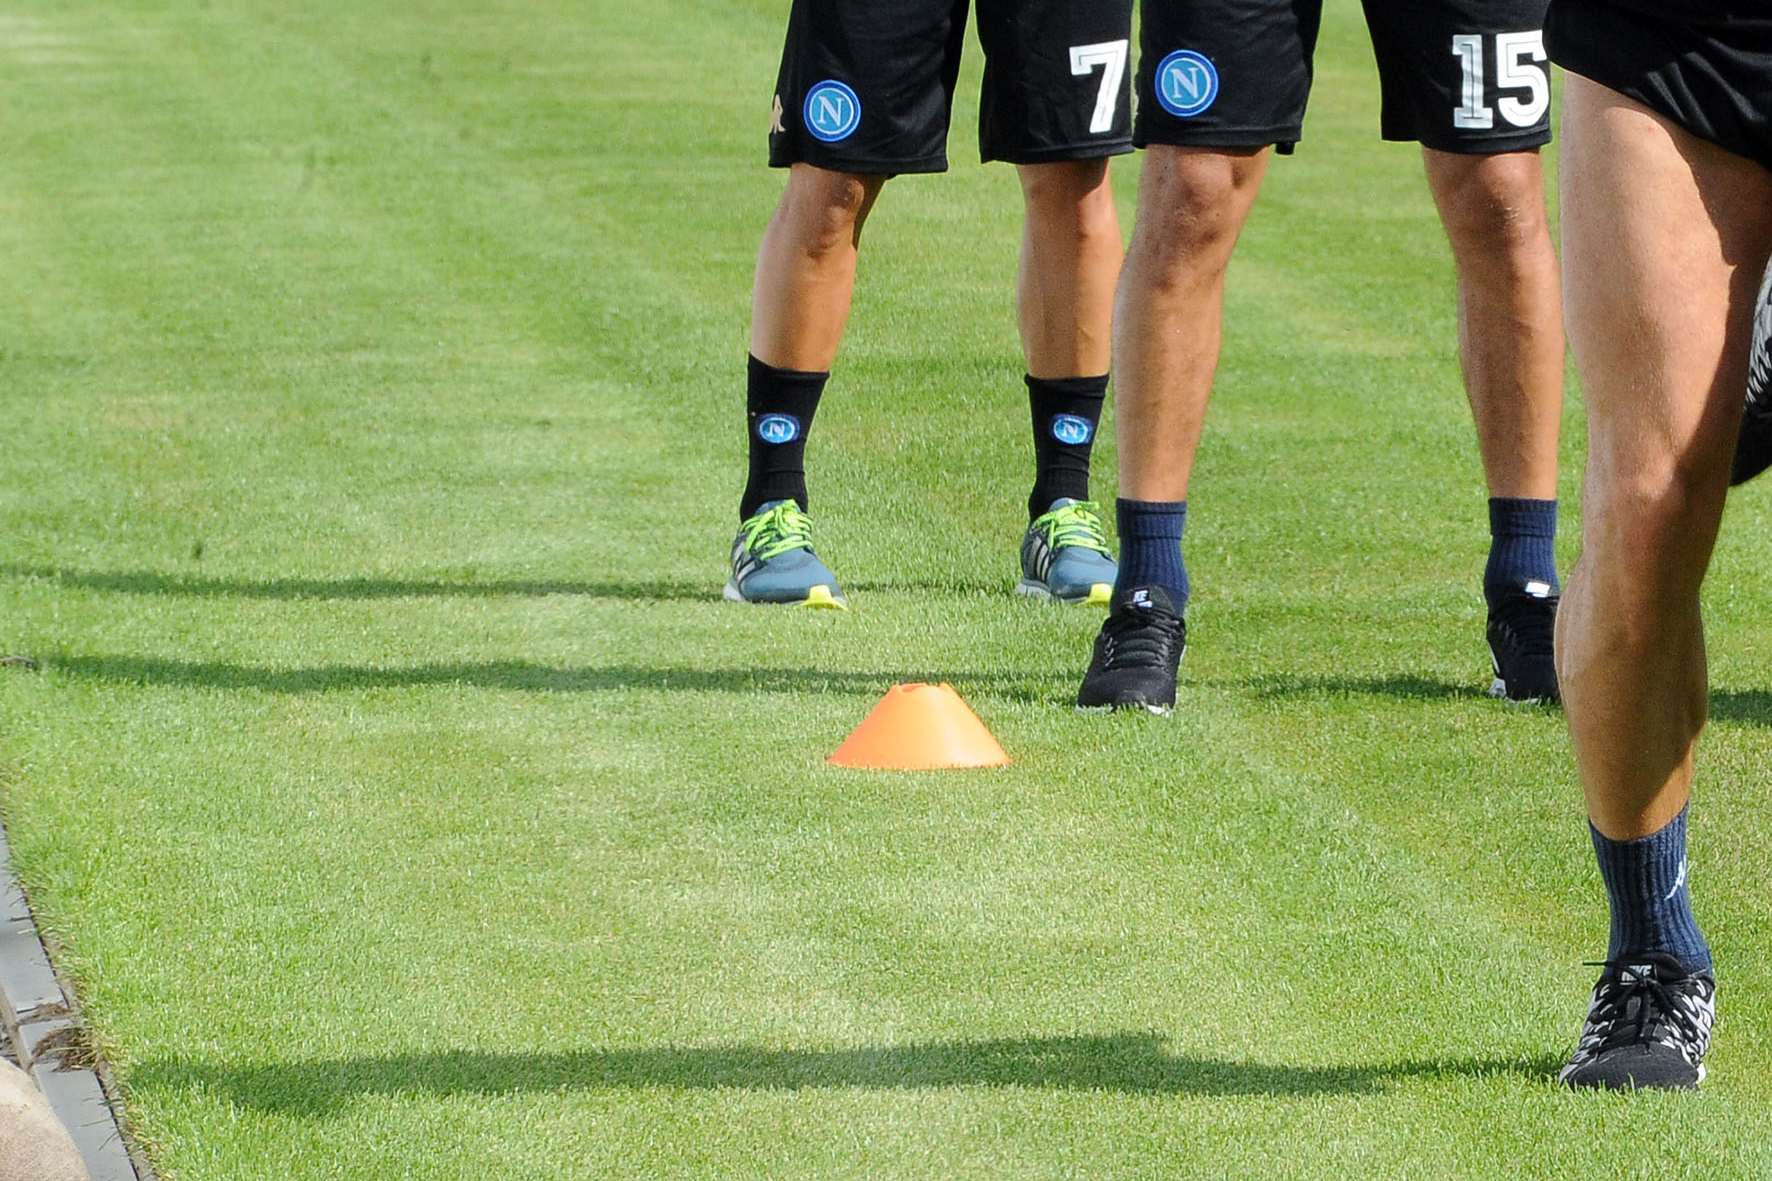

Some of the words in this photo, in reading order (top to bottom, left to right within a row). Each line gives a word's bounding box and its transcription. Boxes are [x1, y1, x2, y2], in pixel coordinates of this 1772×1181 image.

[818, 96, 843, 126] N
[1069, 39, 1128, 133] 7
[1171, 67, 1199, 99] N
[1452, 30, 1550, 130] 15
